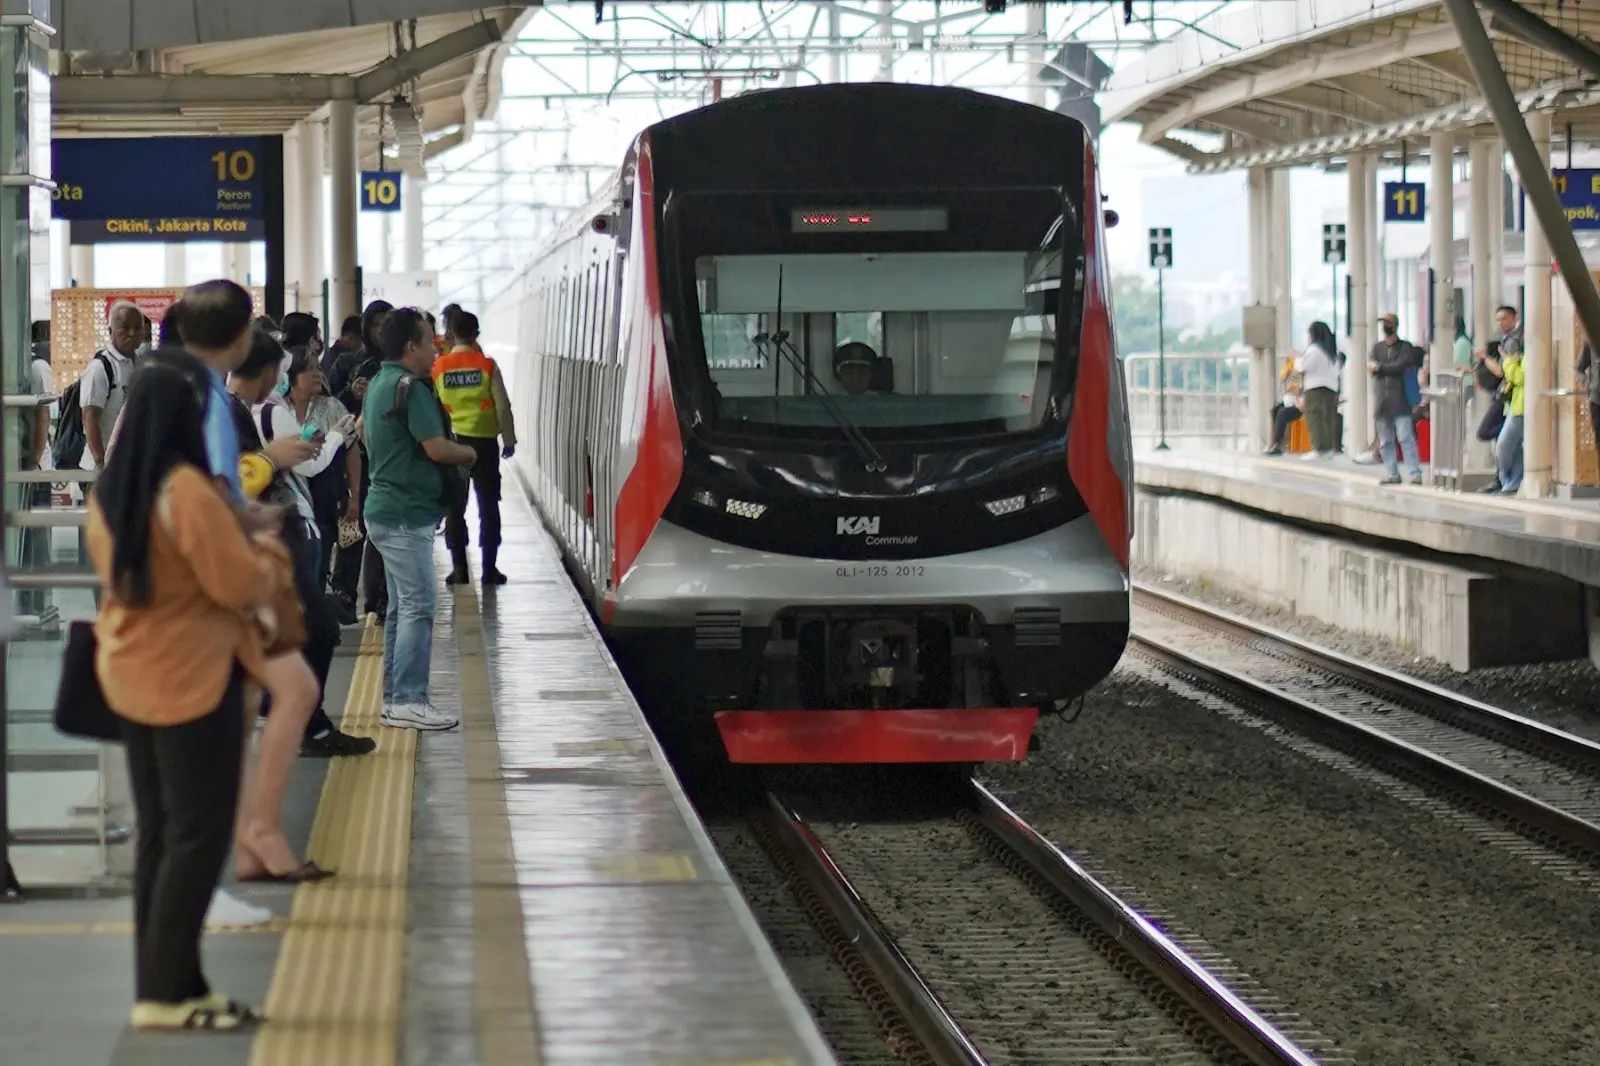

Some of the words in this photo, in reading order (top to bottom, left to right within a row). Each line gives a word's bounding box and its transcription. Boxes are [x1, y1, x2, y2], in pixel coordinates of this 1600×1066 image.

[211, 151, 255, 181] 10
[51, 184, 83, 201] ota
[217, 188, 252, 200] Peron
[364, 179, 397, 205] 10
[1392, 189, 1418, 215] 11
[1563, 205, 1600, 223] pok,
[106, 219, 153, 235] Cikini,
[156, 219, 210, 233] Jakarta
[213, 218, 247, 232] Kota
[836, 515, 881, 535] KAI
[865, 535, 919, 546] Commuter
